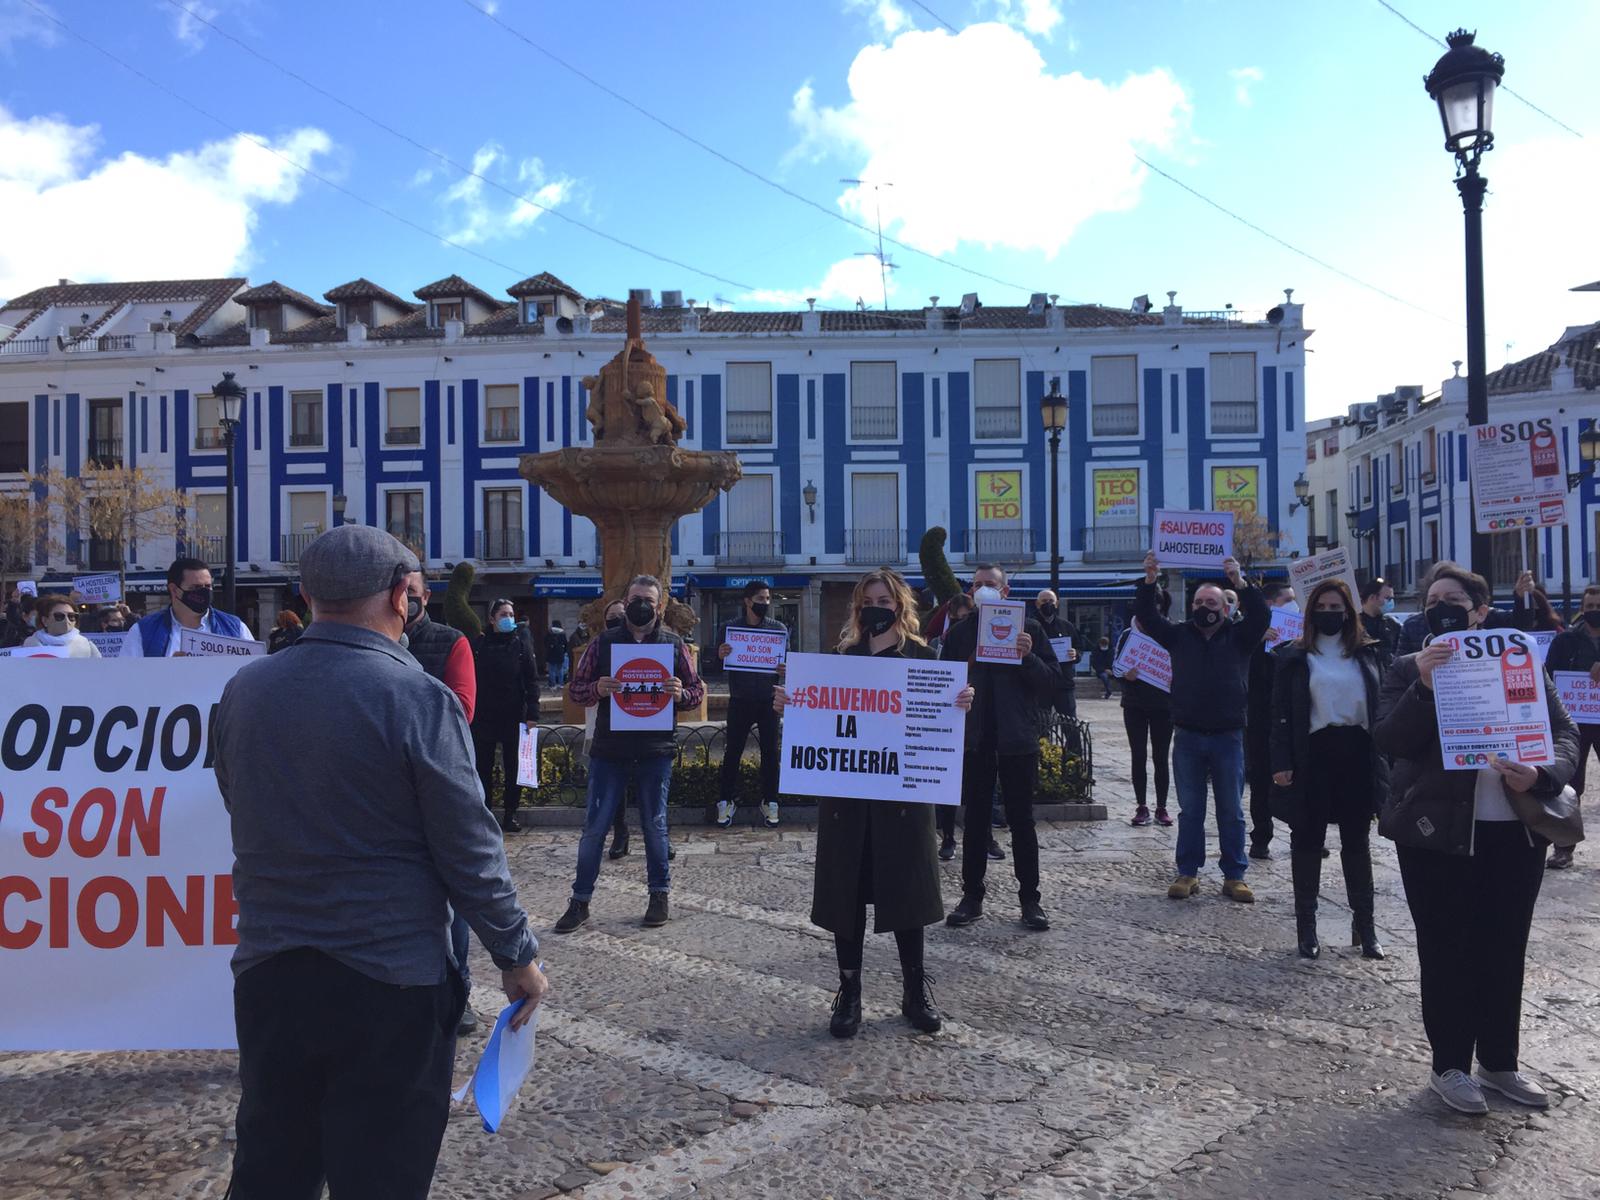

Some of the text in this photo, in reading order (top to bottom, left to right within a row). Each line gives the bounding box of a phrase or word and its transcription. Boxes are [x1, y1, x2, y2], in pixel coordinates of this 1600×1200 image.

[1477, 418, 1553, 443] NO SOS
[1096, 479, 1137, 496] TEO
[979, 502, 1019, 519] TEO
[1159, 520, 1226, 537] #SALVEMOS
[730, 632, 783, 645] ESTAS OPCIONES
[1463, 633, 1529, 659] SOS
[200, 641, 224, 654] SOLO
[226, 645, 251, 656] FALTA
[747, 645, 772, 654] NO SON
[737, 654, 778, 665] SOLUCIONES
[1571, 680, 1587, 689] LOS
[791, 685, 902, 714] #SALVEMOS
[1563, 692, 1575, 700] NO
[836, 714, 858, 739] LA
[790, 746, 900, 775] HOSTELERÍA
[22, 786, 168, 858] SON
